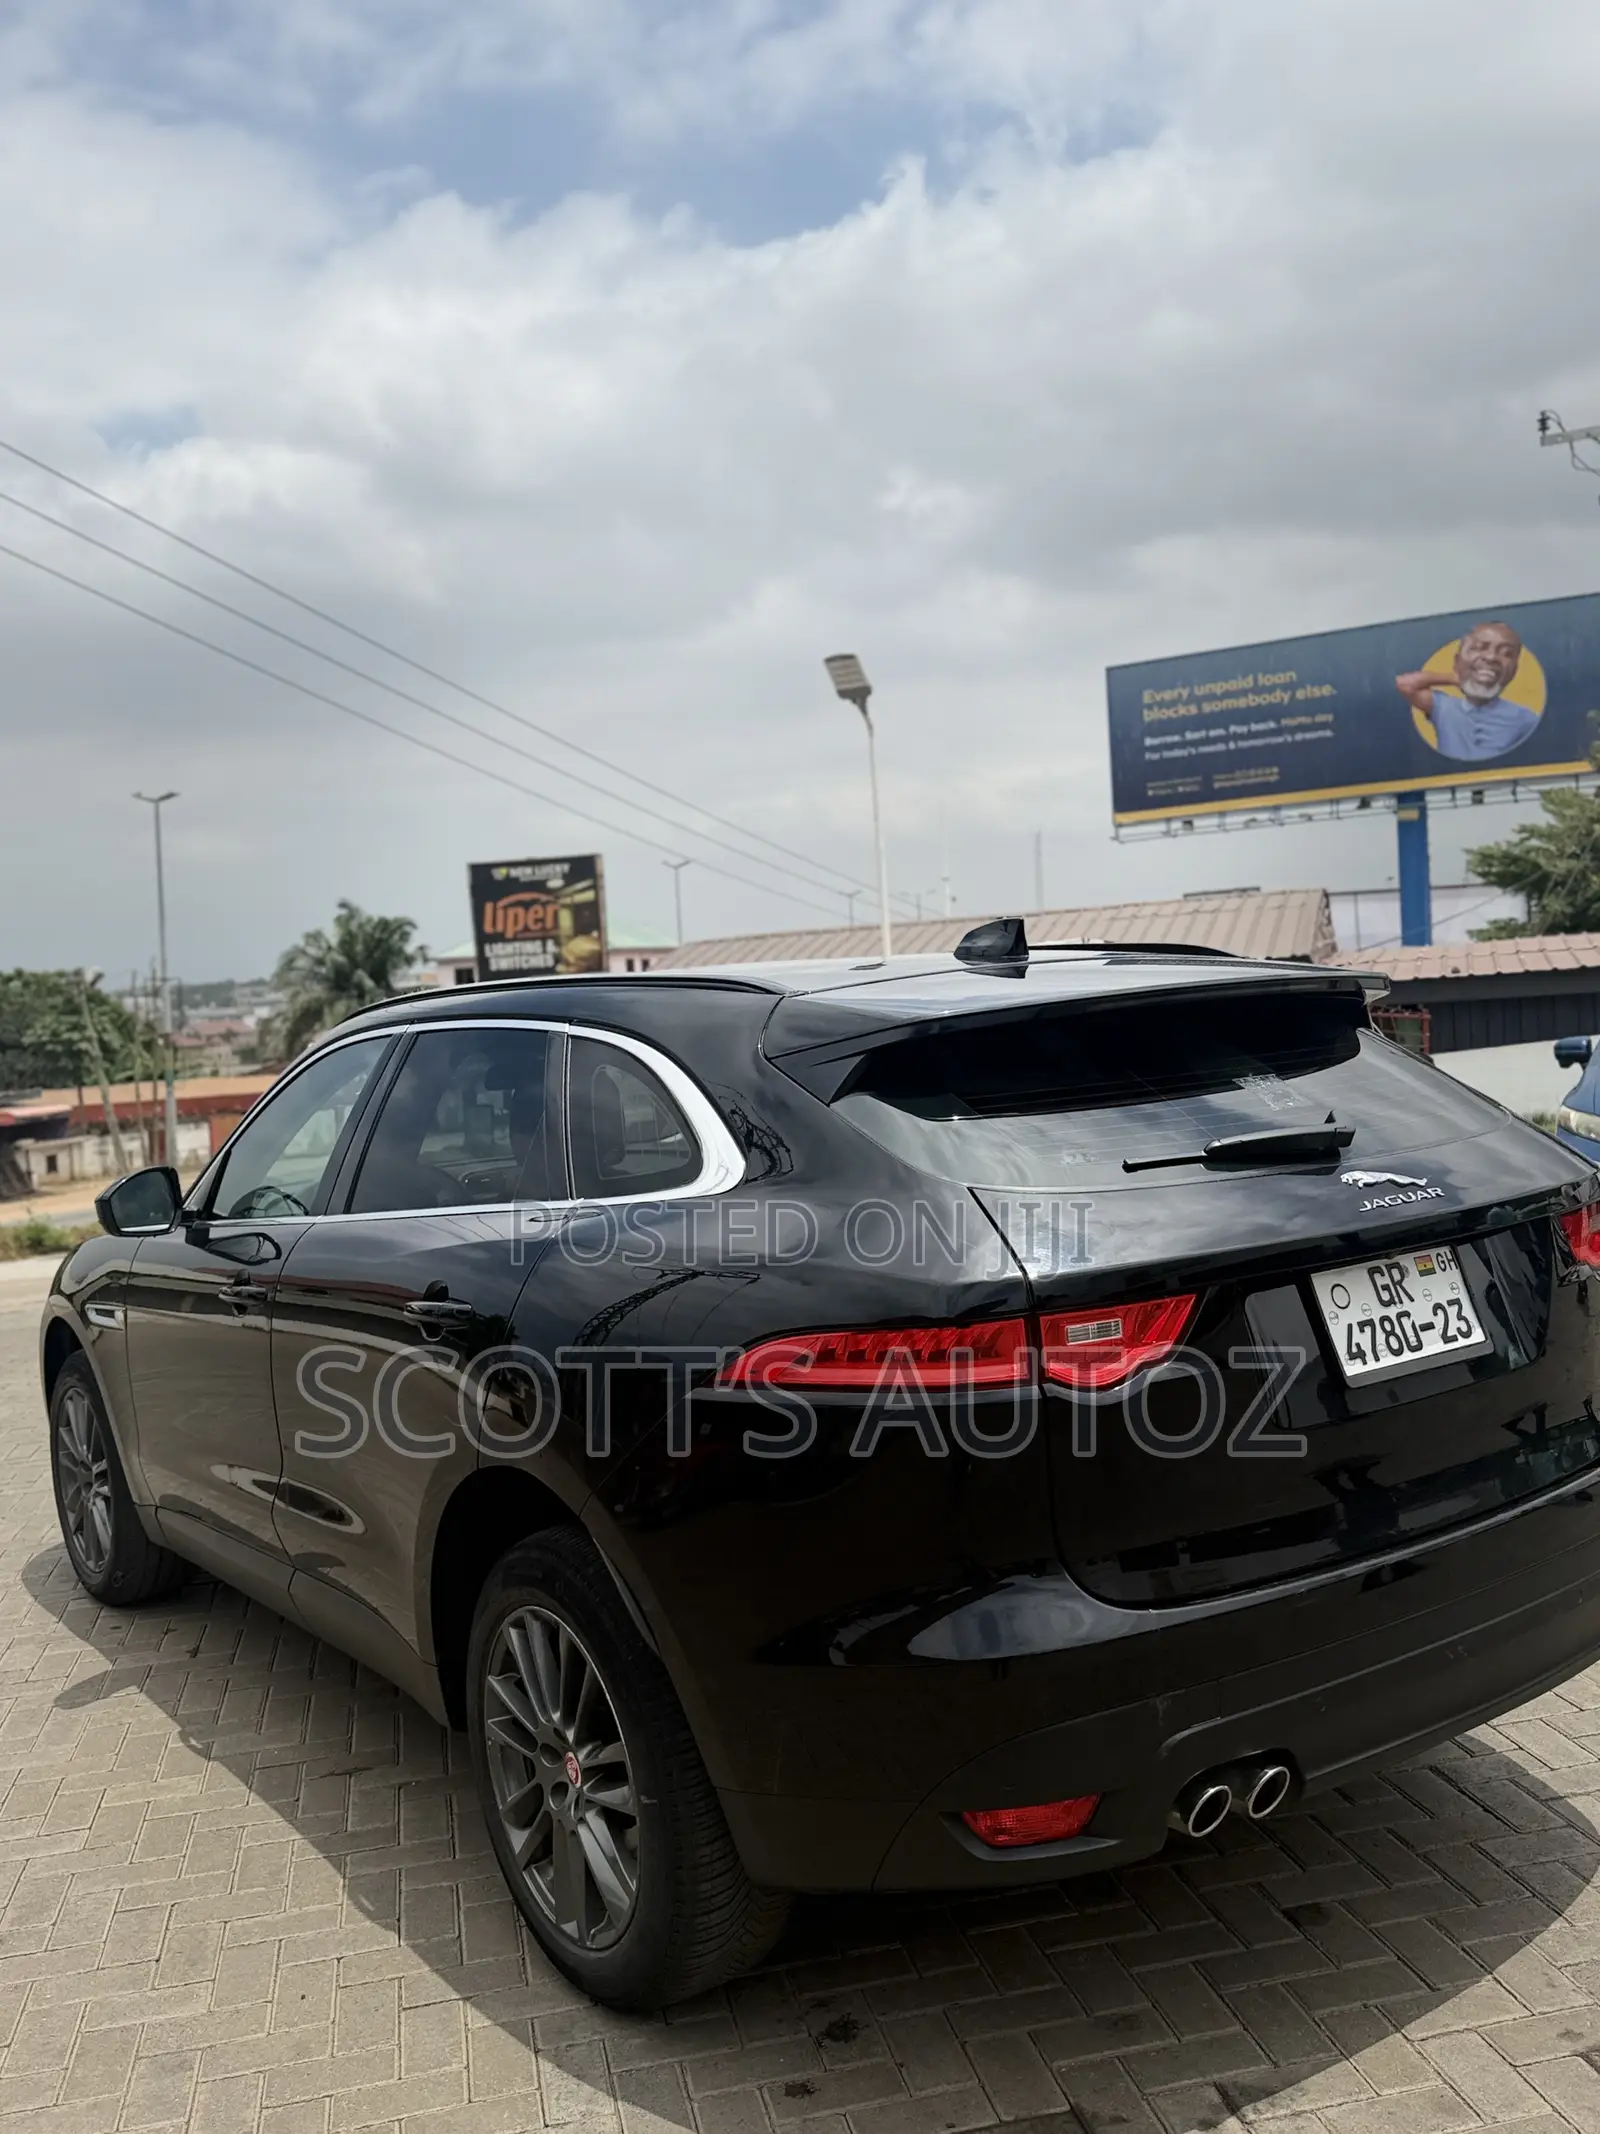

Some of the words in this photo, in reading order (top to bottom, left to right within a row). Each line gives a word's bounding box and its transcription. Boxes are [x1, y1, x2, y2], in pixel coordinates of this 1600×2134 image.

[1143, 687, 1189, 704] Every
[1194, 674, 1254, 696] unpaid
[1258, 670, 1298, 687] loan
[1143, 703, 1198, 722] blocks
[1202, 688, 1291, 713] somebody
[1295, 683, 1337, 700] else.
[1229, 724, 1249, 736] Pay
[1359, 1187, 1446, 1212] JAGUAR
[1435, 1250, 1459, 1273] GH
[1368, 1261, 1415, 1308] GR
[1346, 1297, 1473, 1366] 4780-23
